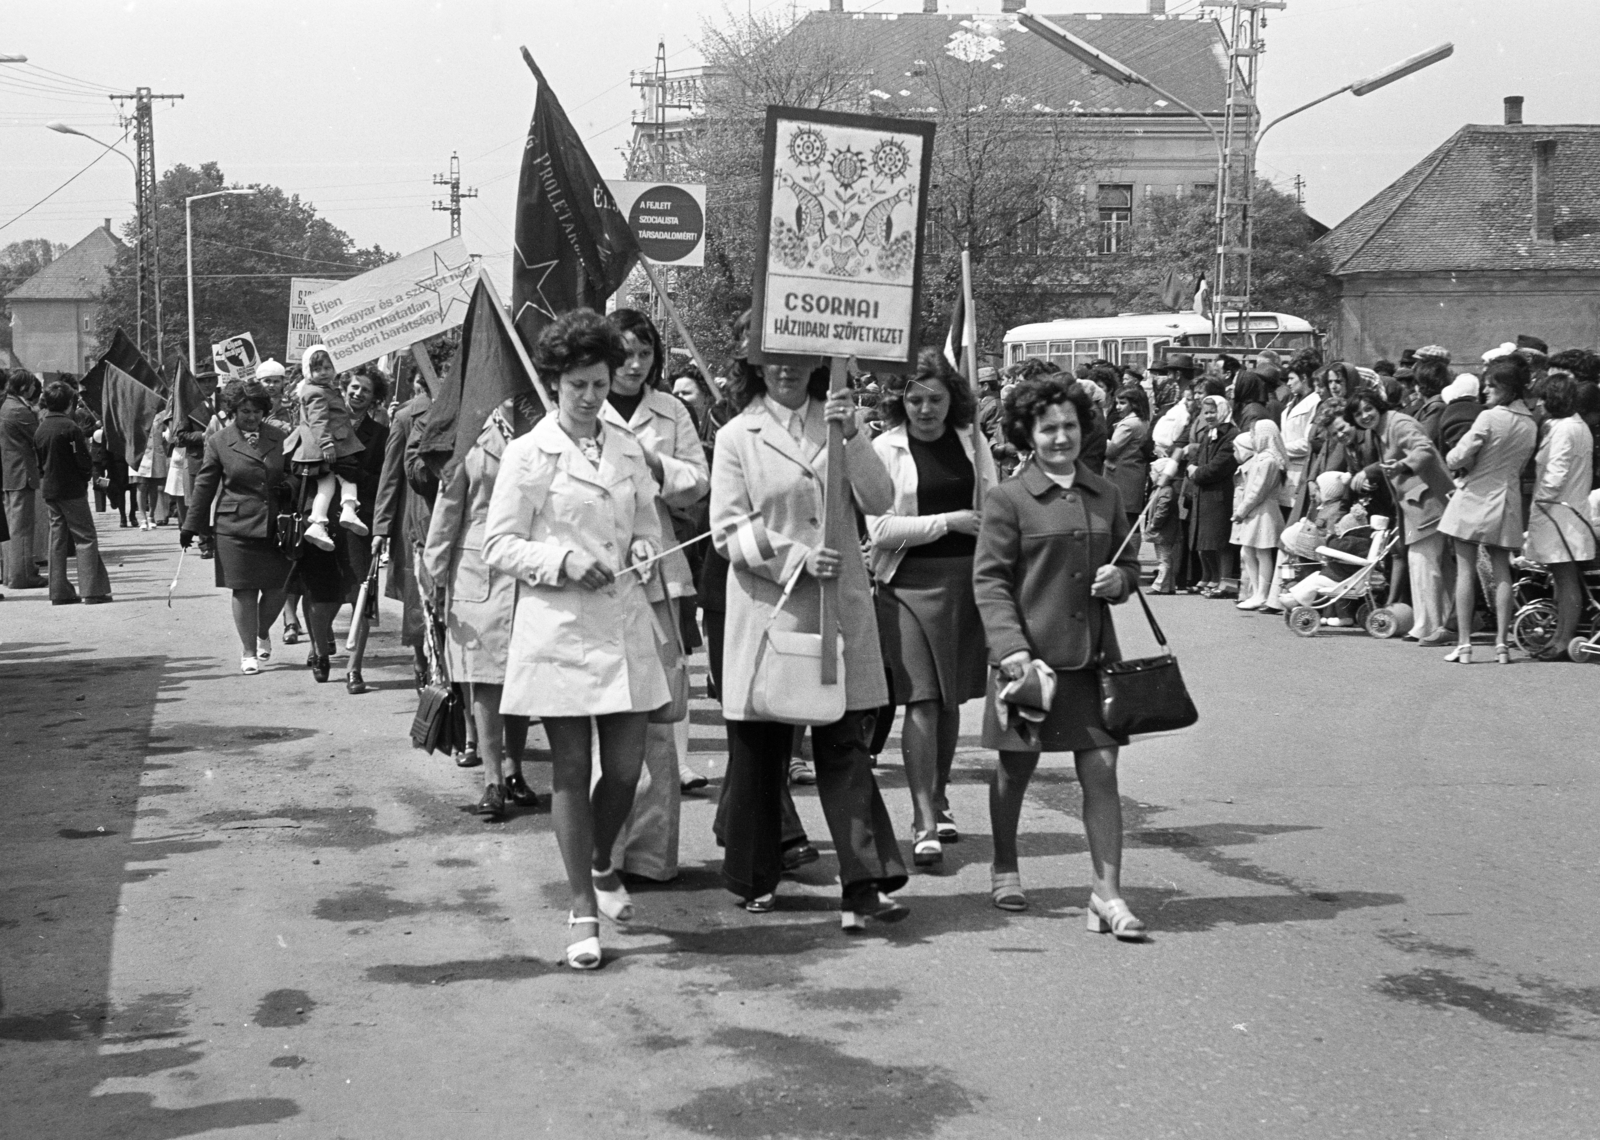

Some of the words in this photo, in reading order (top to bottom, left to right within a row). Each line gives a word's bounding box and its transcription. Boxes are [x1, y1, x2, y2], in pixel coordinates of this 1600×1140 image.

[640, 201, 645, 209] A
[646, 202, 672, 210] FEJLETT
[639, 215, 679, 225] SZOCIALISTA
[638, 230, 697, 240] TÁRSADALOMÉRT!
[312, 298, 343, 315] Éljen
[321, 325, 330, 333] a
[331, 308, 372, 329] magyar
[379, 299, 393, 310] és
[395, 295, 404, 303] a
[405, 276, 448, 299] szovjet
[449, 266, 473, 282] nép
[785, 292, 879, 319] CSORNAI
[327, 300, 431, 347] megbonthatatlan
[774, 315, 829, 339] HÁZIIPARI
[833, 321, 904, 344] SZÖVETKEZET
[333, 334, 380, 361] testvéri
